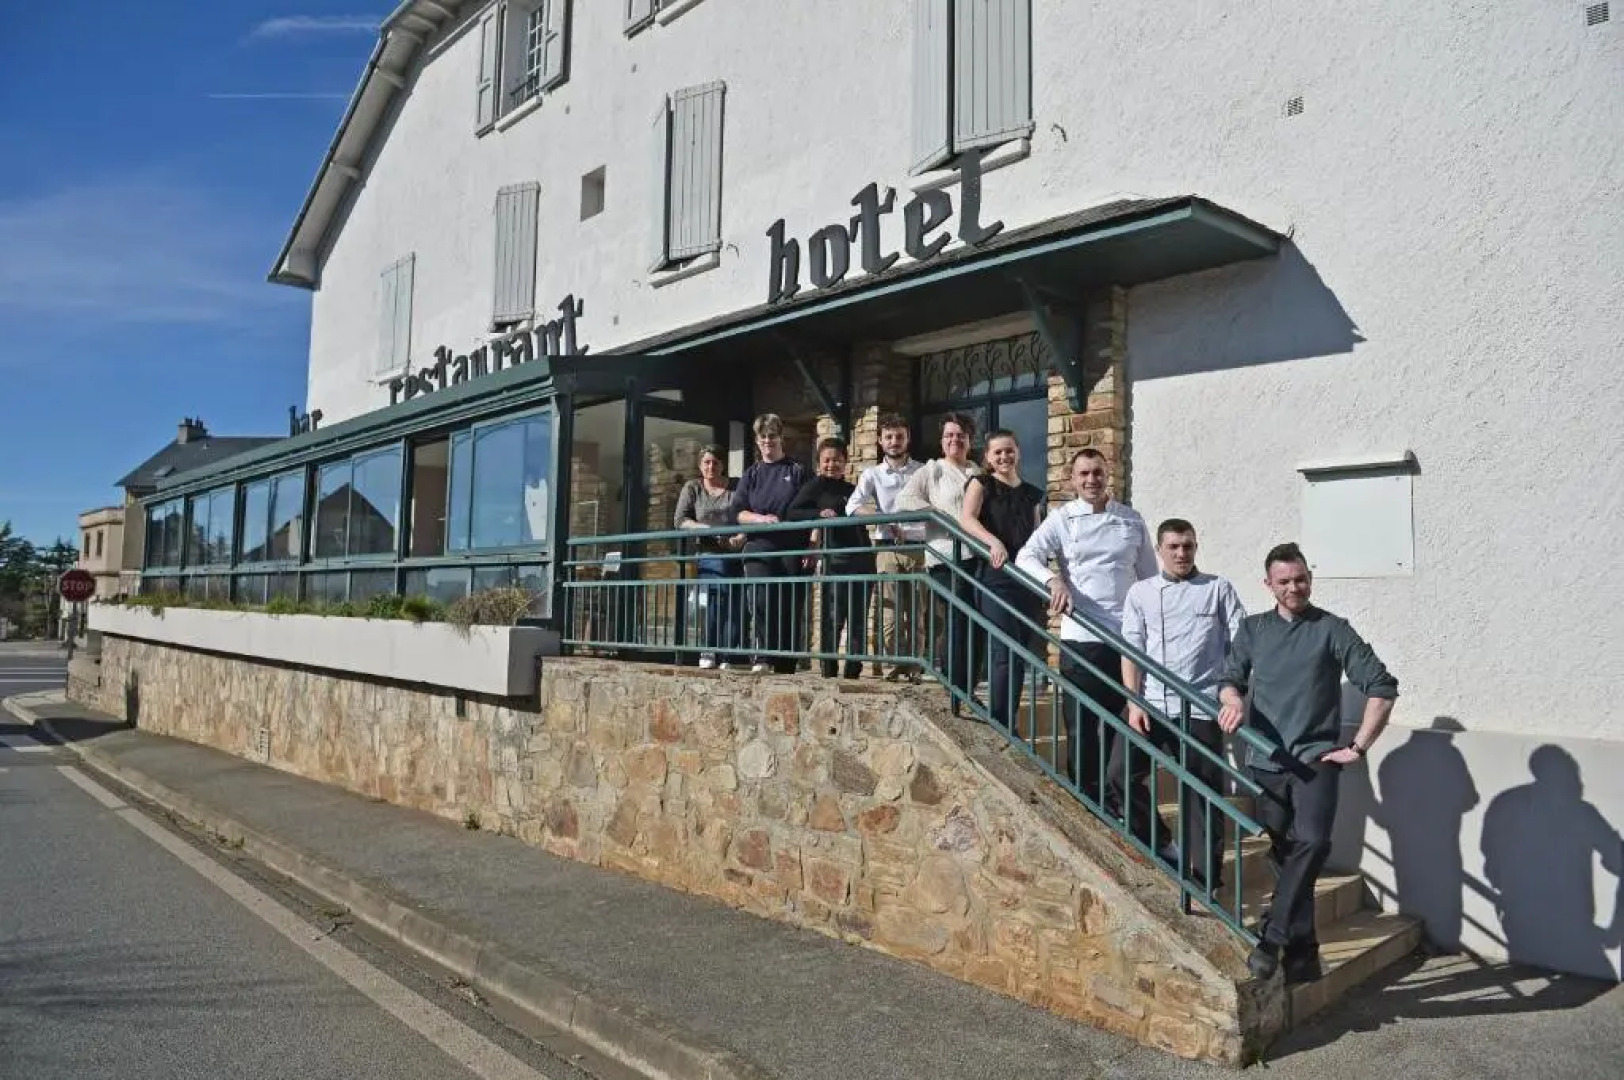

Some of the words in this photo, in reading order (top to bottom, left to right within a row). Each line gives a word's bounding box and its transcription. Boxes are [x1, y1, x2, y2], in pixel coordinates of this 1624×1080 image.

[766, 151, 1004, 304] hotel
[389, 293, 589, 405] restaurant
[289, 405, 323, 438] bar
[62, 579, 93, 592] STOP
